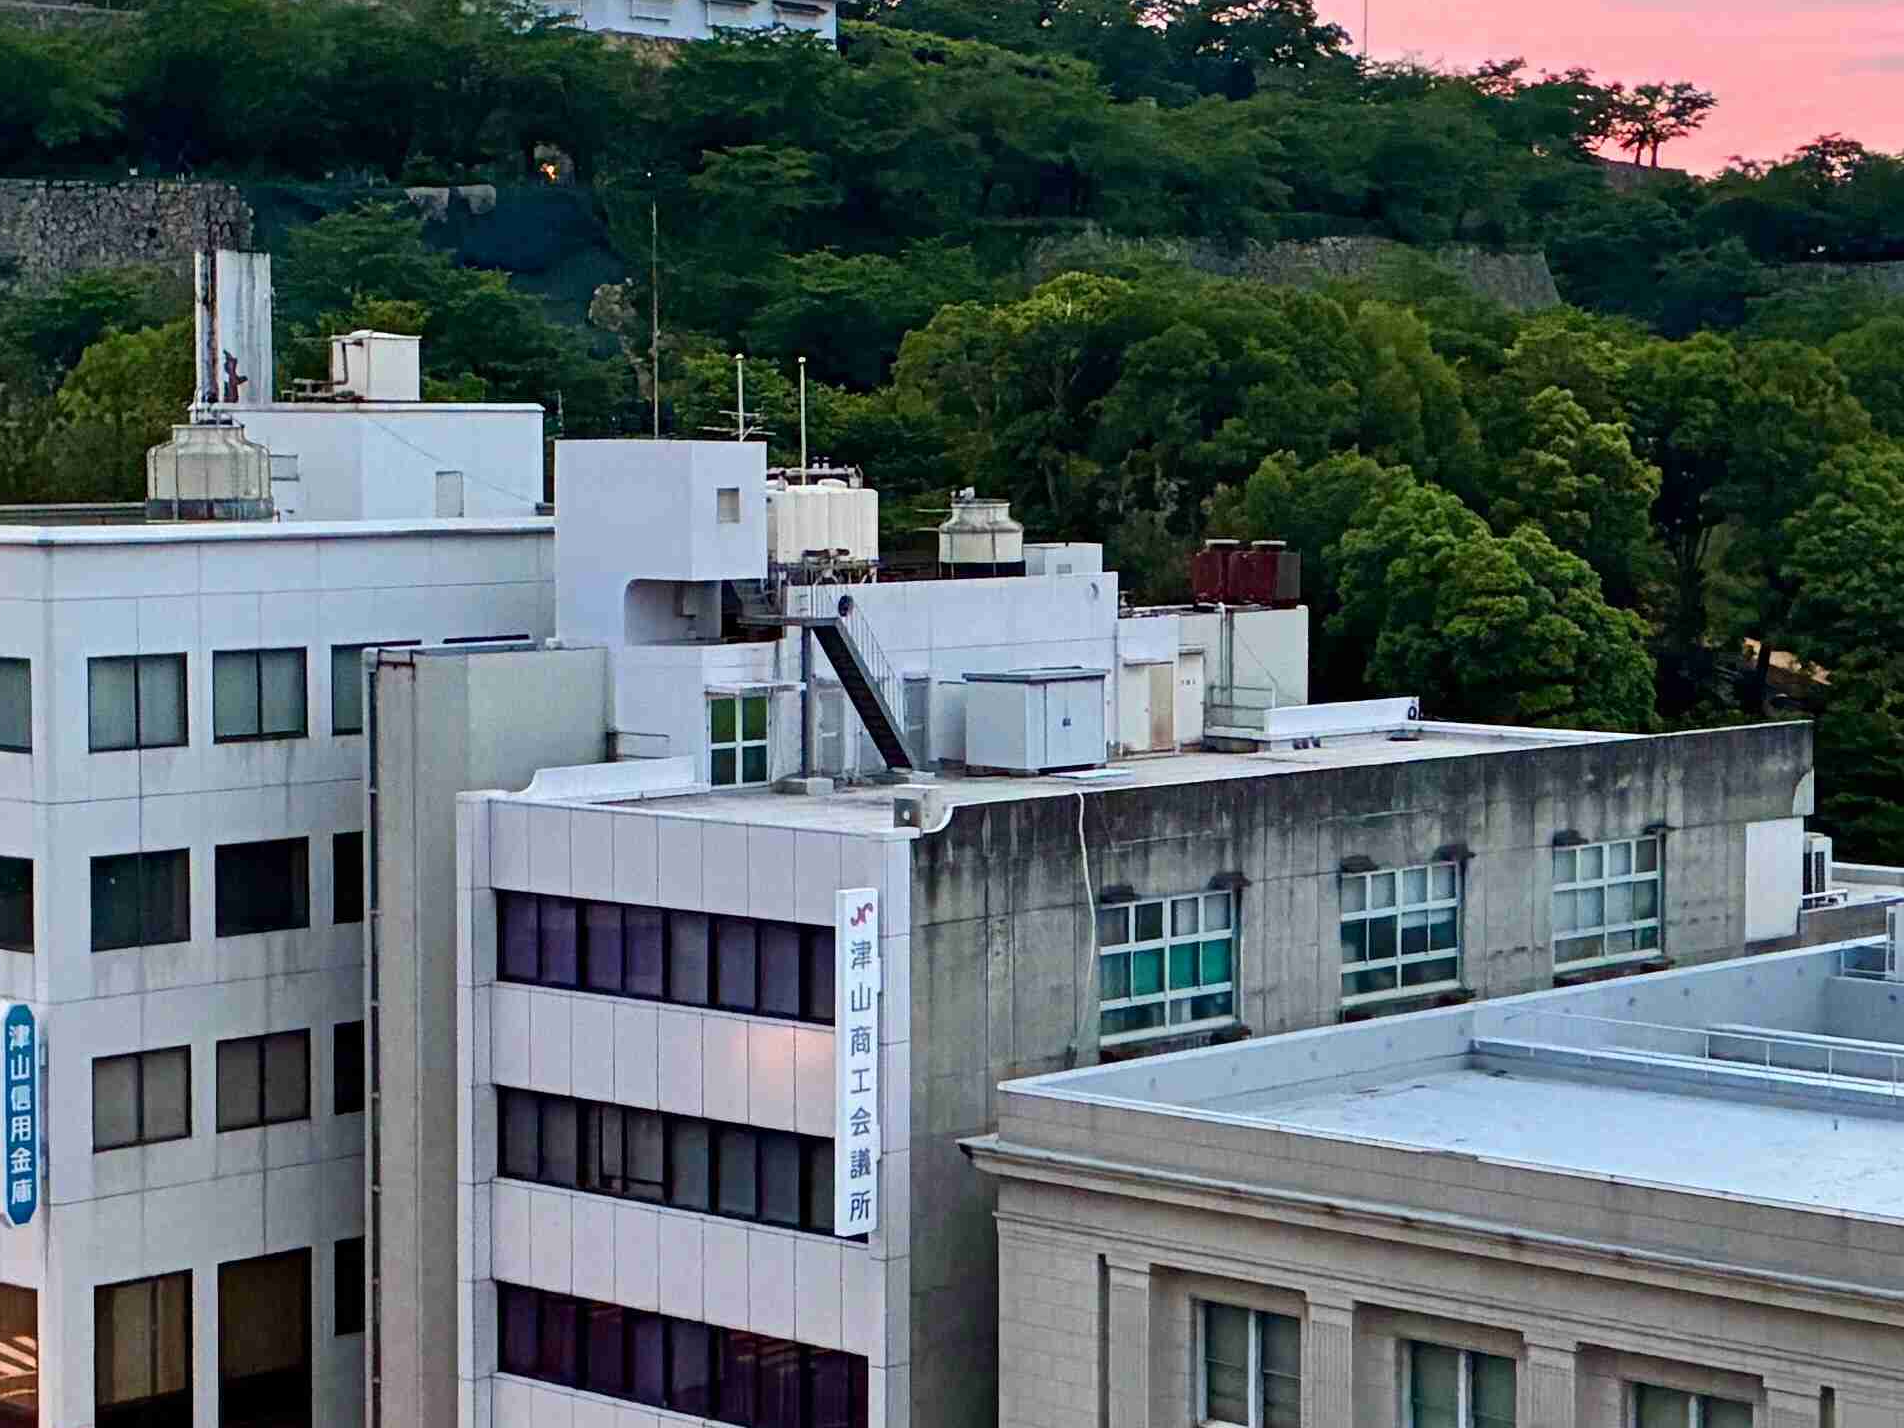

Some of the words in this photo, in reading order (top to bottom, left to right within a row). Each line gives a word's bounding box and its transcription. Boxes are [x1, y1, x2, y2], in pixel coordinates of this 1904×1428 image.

[9, 1024, 33, 1205] 津山信用金庫
[850, 939, 873, 1222] 津山商工会議所
